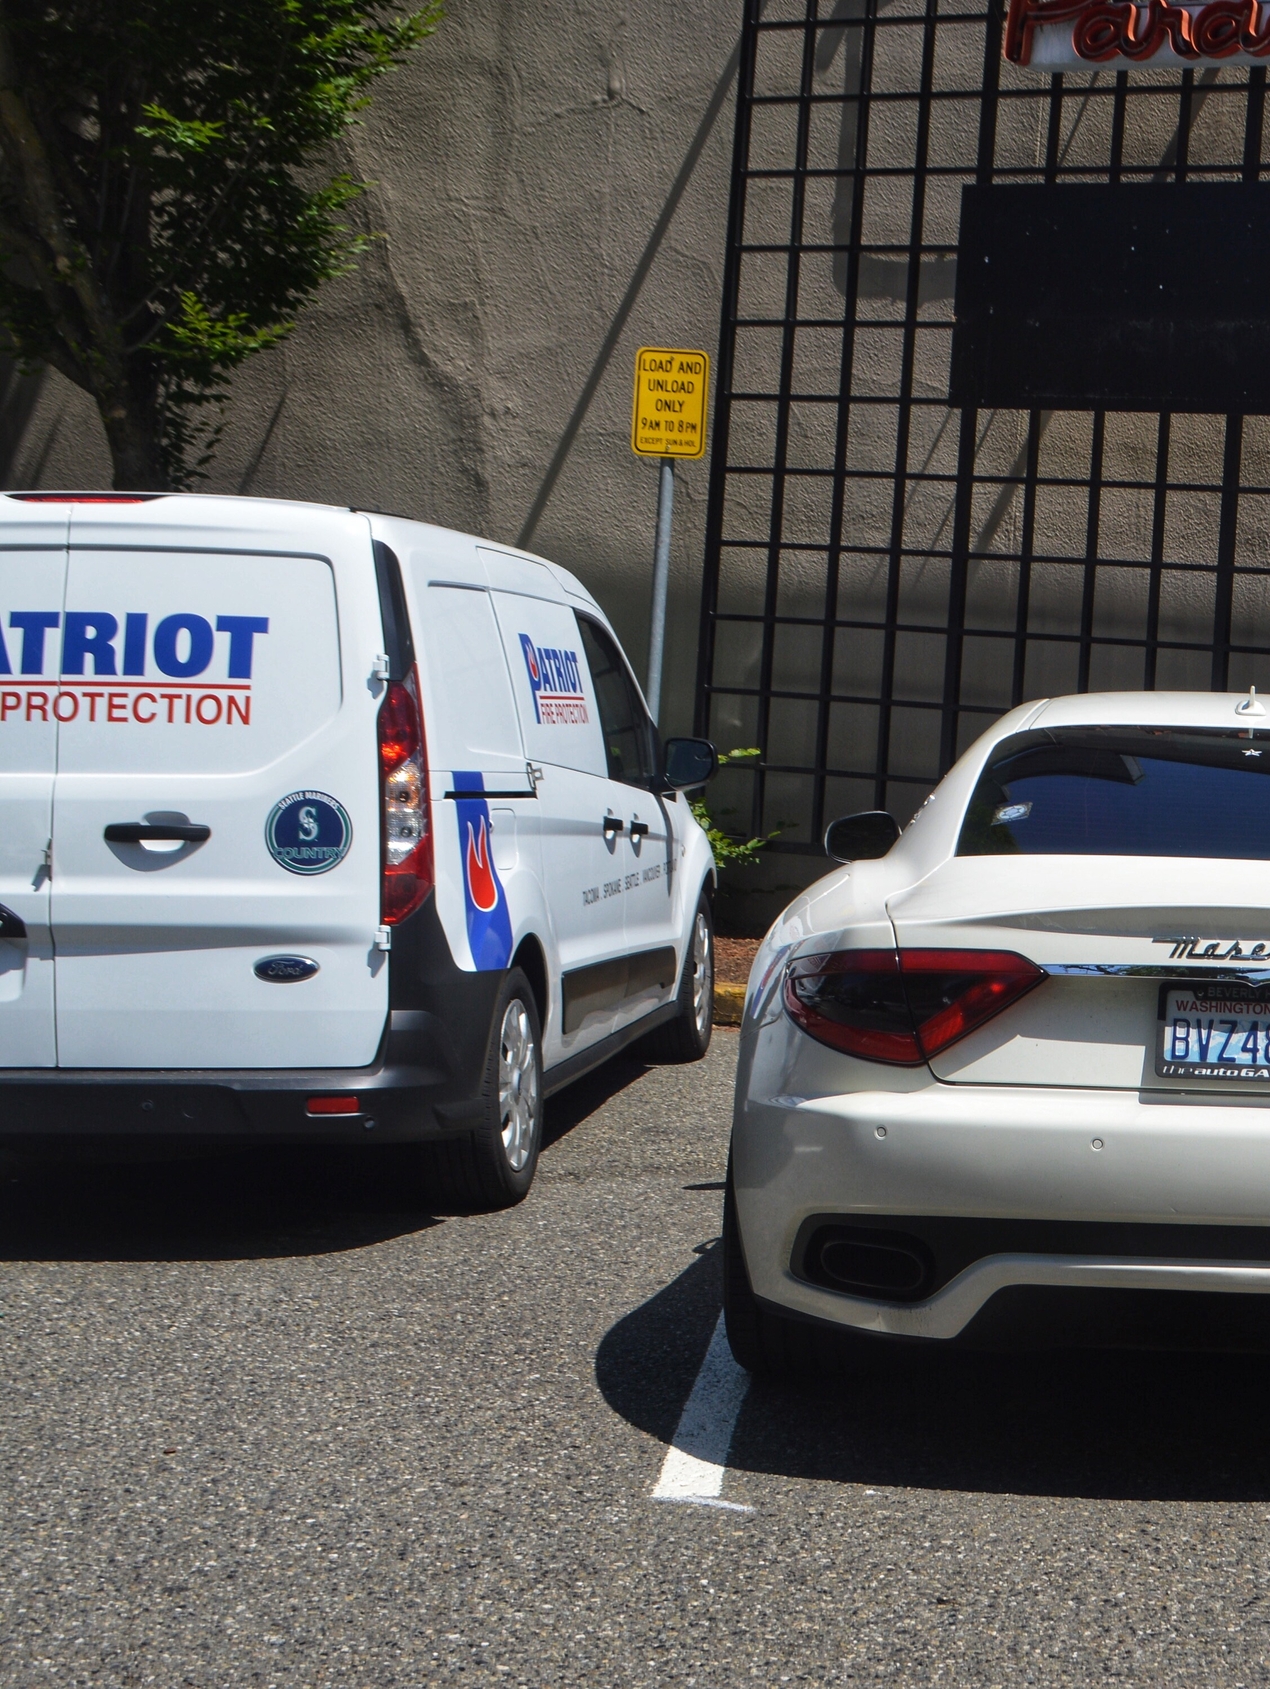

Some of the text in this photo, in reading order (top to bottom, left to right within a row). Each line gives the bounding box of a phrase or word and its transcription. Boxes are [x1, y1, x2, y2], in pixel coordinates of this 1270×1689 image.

[643, 358, 702, 375] LOAD AND
[648, 378, 695, 394] UNLOAD
[655, 398, 685, 413] ONLY
[664, 420, 675, 432] TO
[0, 611, 270, 680] TRIOT
[518, 633, 584, 724] PATRIOT
[0, 691, 251, 726] PROTECTION
[273, 846, 345, 859] COUNTRY
[1207, 986, 1264, 999] BEVERLY
